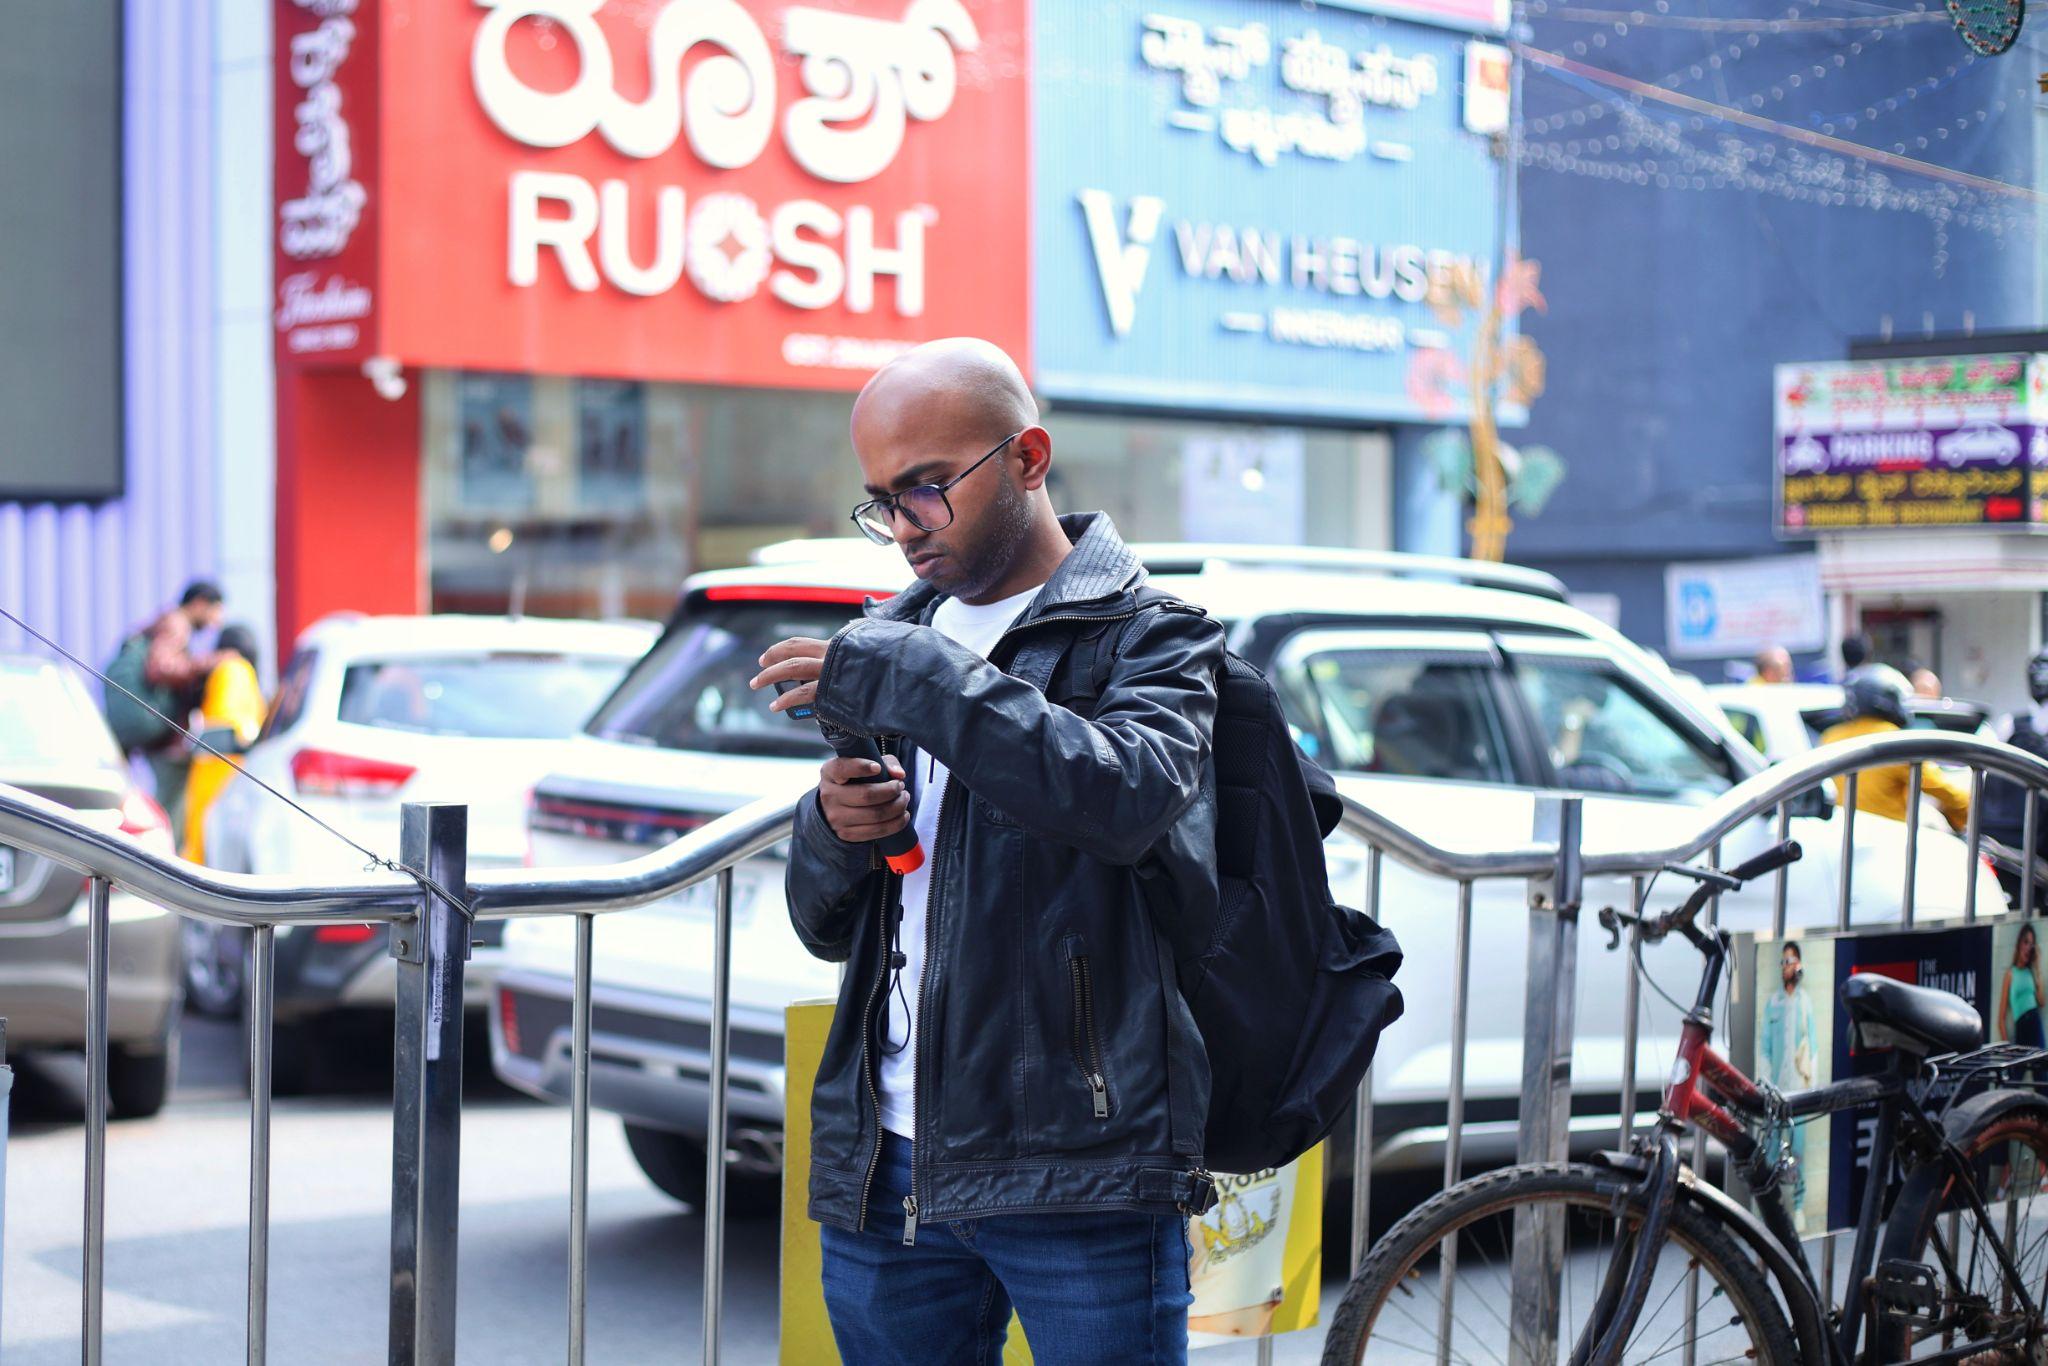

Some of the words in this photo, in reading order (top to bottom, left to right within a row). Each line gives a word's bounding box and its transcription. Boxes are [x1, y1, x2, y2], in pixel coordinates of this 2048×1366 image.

[508, 170, 925, 317] RUOSH
[1173, 219, 1280, 287] VAN
[1829, 432, 1934, 467] PARKING
